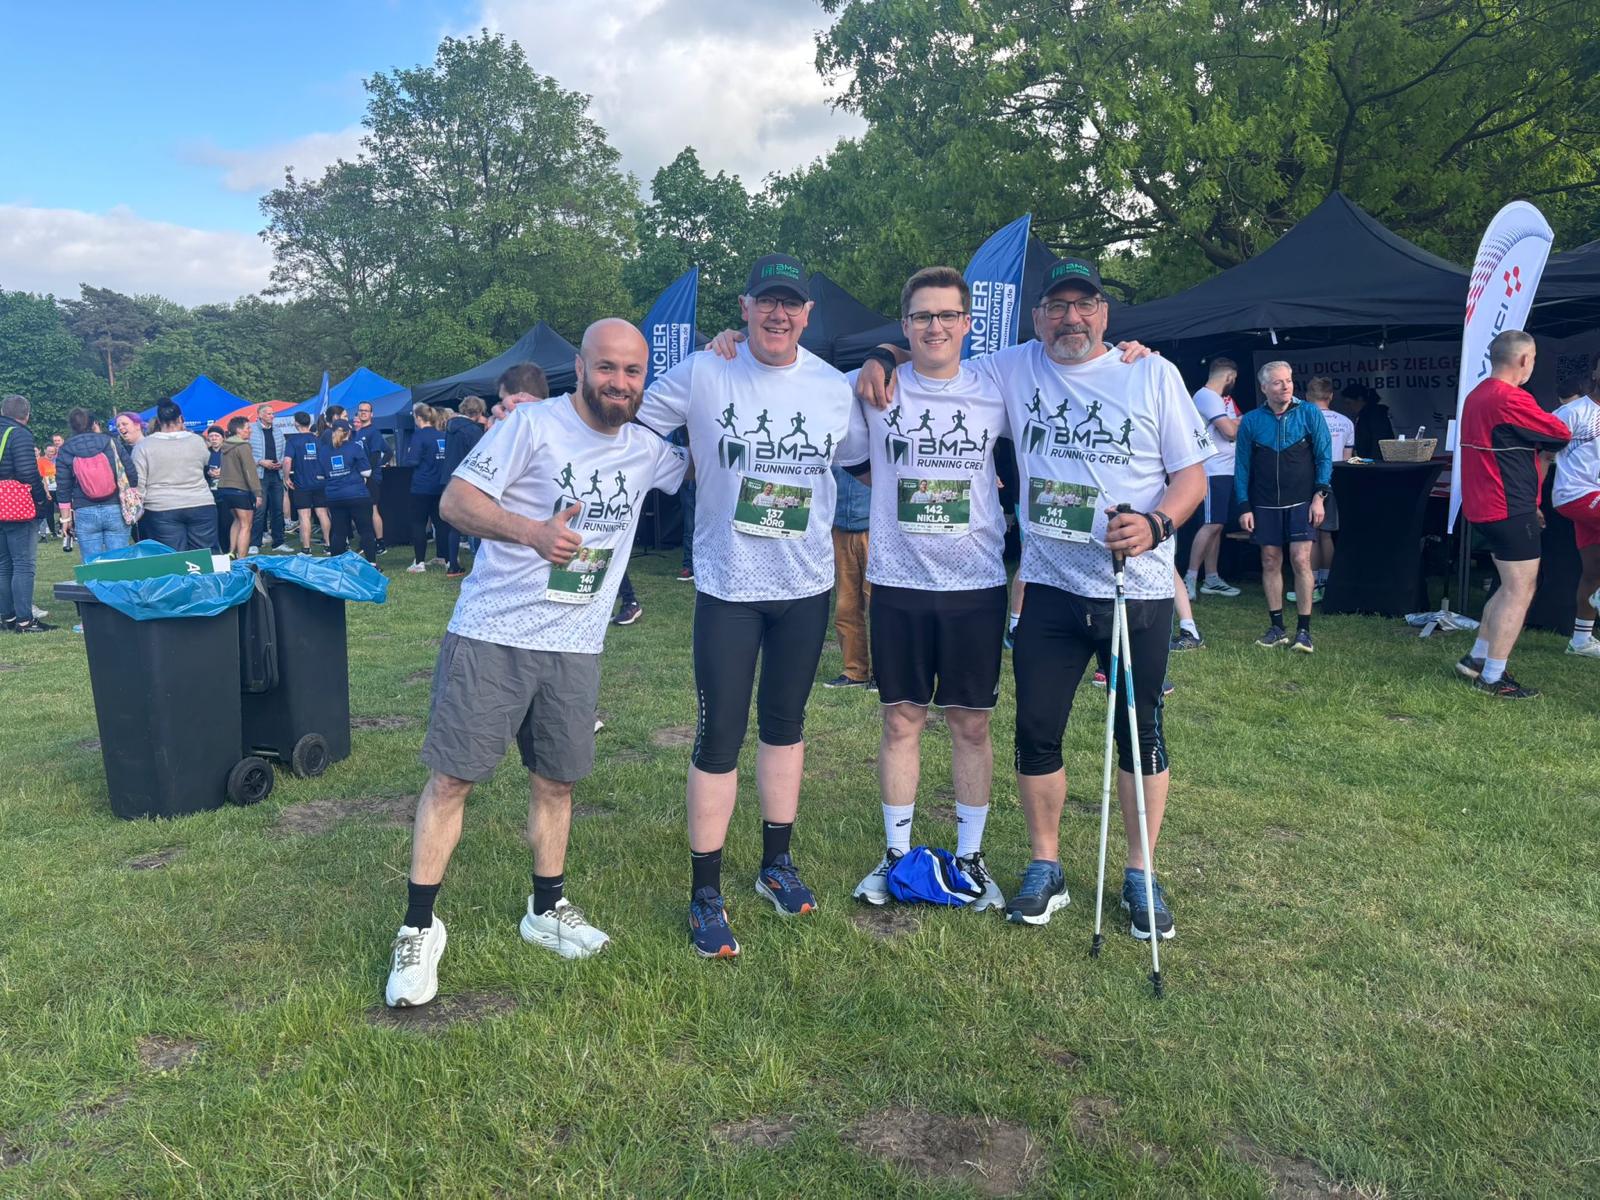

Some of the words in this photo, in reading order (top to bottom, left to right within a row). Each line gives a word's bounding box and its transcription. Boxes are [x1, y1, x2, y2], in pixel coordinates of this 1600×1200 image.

[989, 282, 1004, 352] Monitoring
[1477, 302, 1509, 379] VICI
[1314, 360, 1351, 374] DICH
[1357, 358, 1398, 372] AUFS
[1374, 376, 1400, 389] BEI
[1406, 375, 1440, 389] UNS
[1054, 426, 1114, 449] BMP
[755, 441, 819, 461] BMP
[918, 438, 977, 456] BMP
[1050, 448, 1096, 462] RUNNING
[1099, 455, 1130, 465] CREW
[754, 463, 801, 475] RUNNING
[804, 466, 827, 475] CREW
[917, 458, 962, 469] RUNNING
[588, 502, 630, 520] BMP
[766, 508, 784, 519] 137
[924, 505, 943, 514] 142
[1046, 506, 1063, 517] 141
[916, 514, 950, 523] NIKLAS
[1039, 516, 1068, 528] KLAUS
[580, 574, 595, 584] 140
[576, 584, 592, 593] JAN
